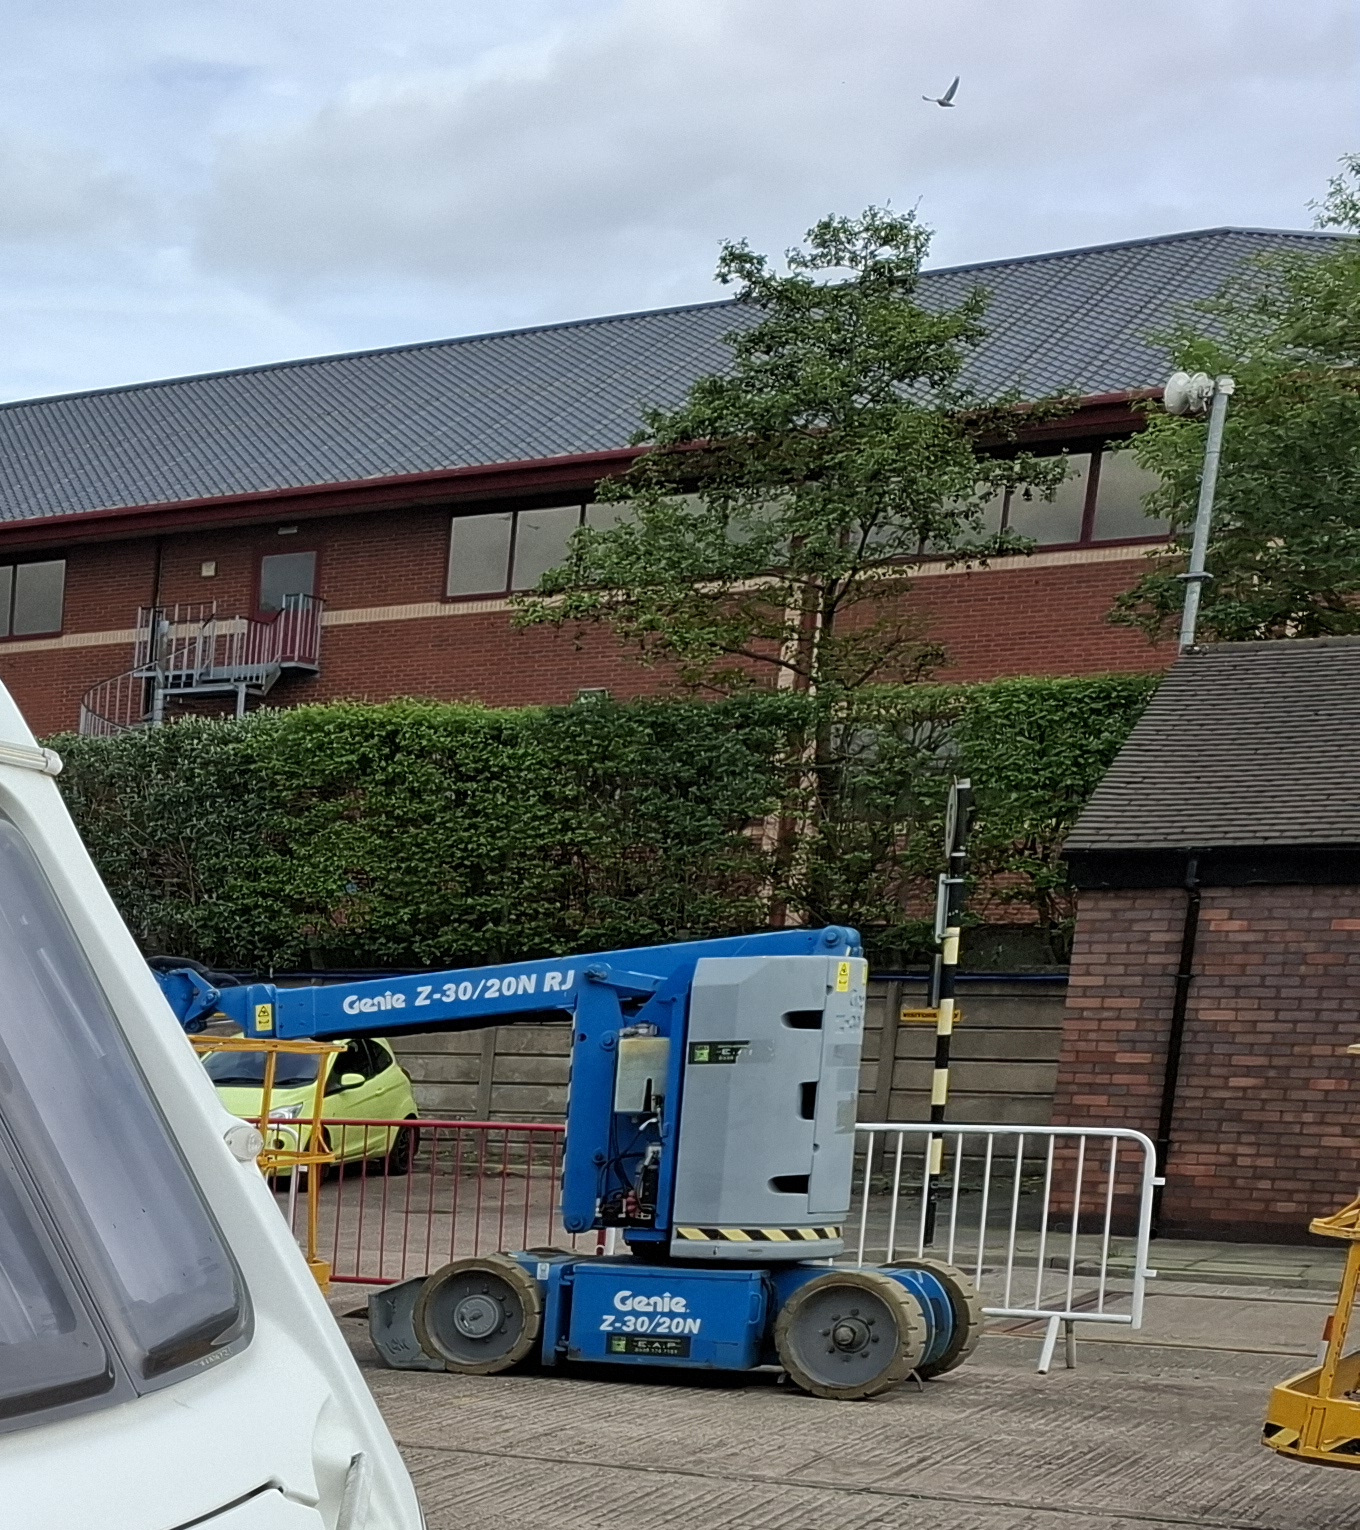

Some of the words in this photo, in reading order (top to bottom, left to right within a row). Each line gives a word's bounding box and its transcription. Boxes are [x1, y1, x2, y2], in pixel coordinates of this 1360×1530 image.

[343, 990, 406, 1015] Genie
[415, 973, 537, 1006] Z-30/20N
[543, 970, 576, 992] RJ
[613, 1290, 688, 1313] Genie
[599, 1314, 702, 1334] Z-30/20N
